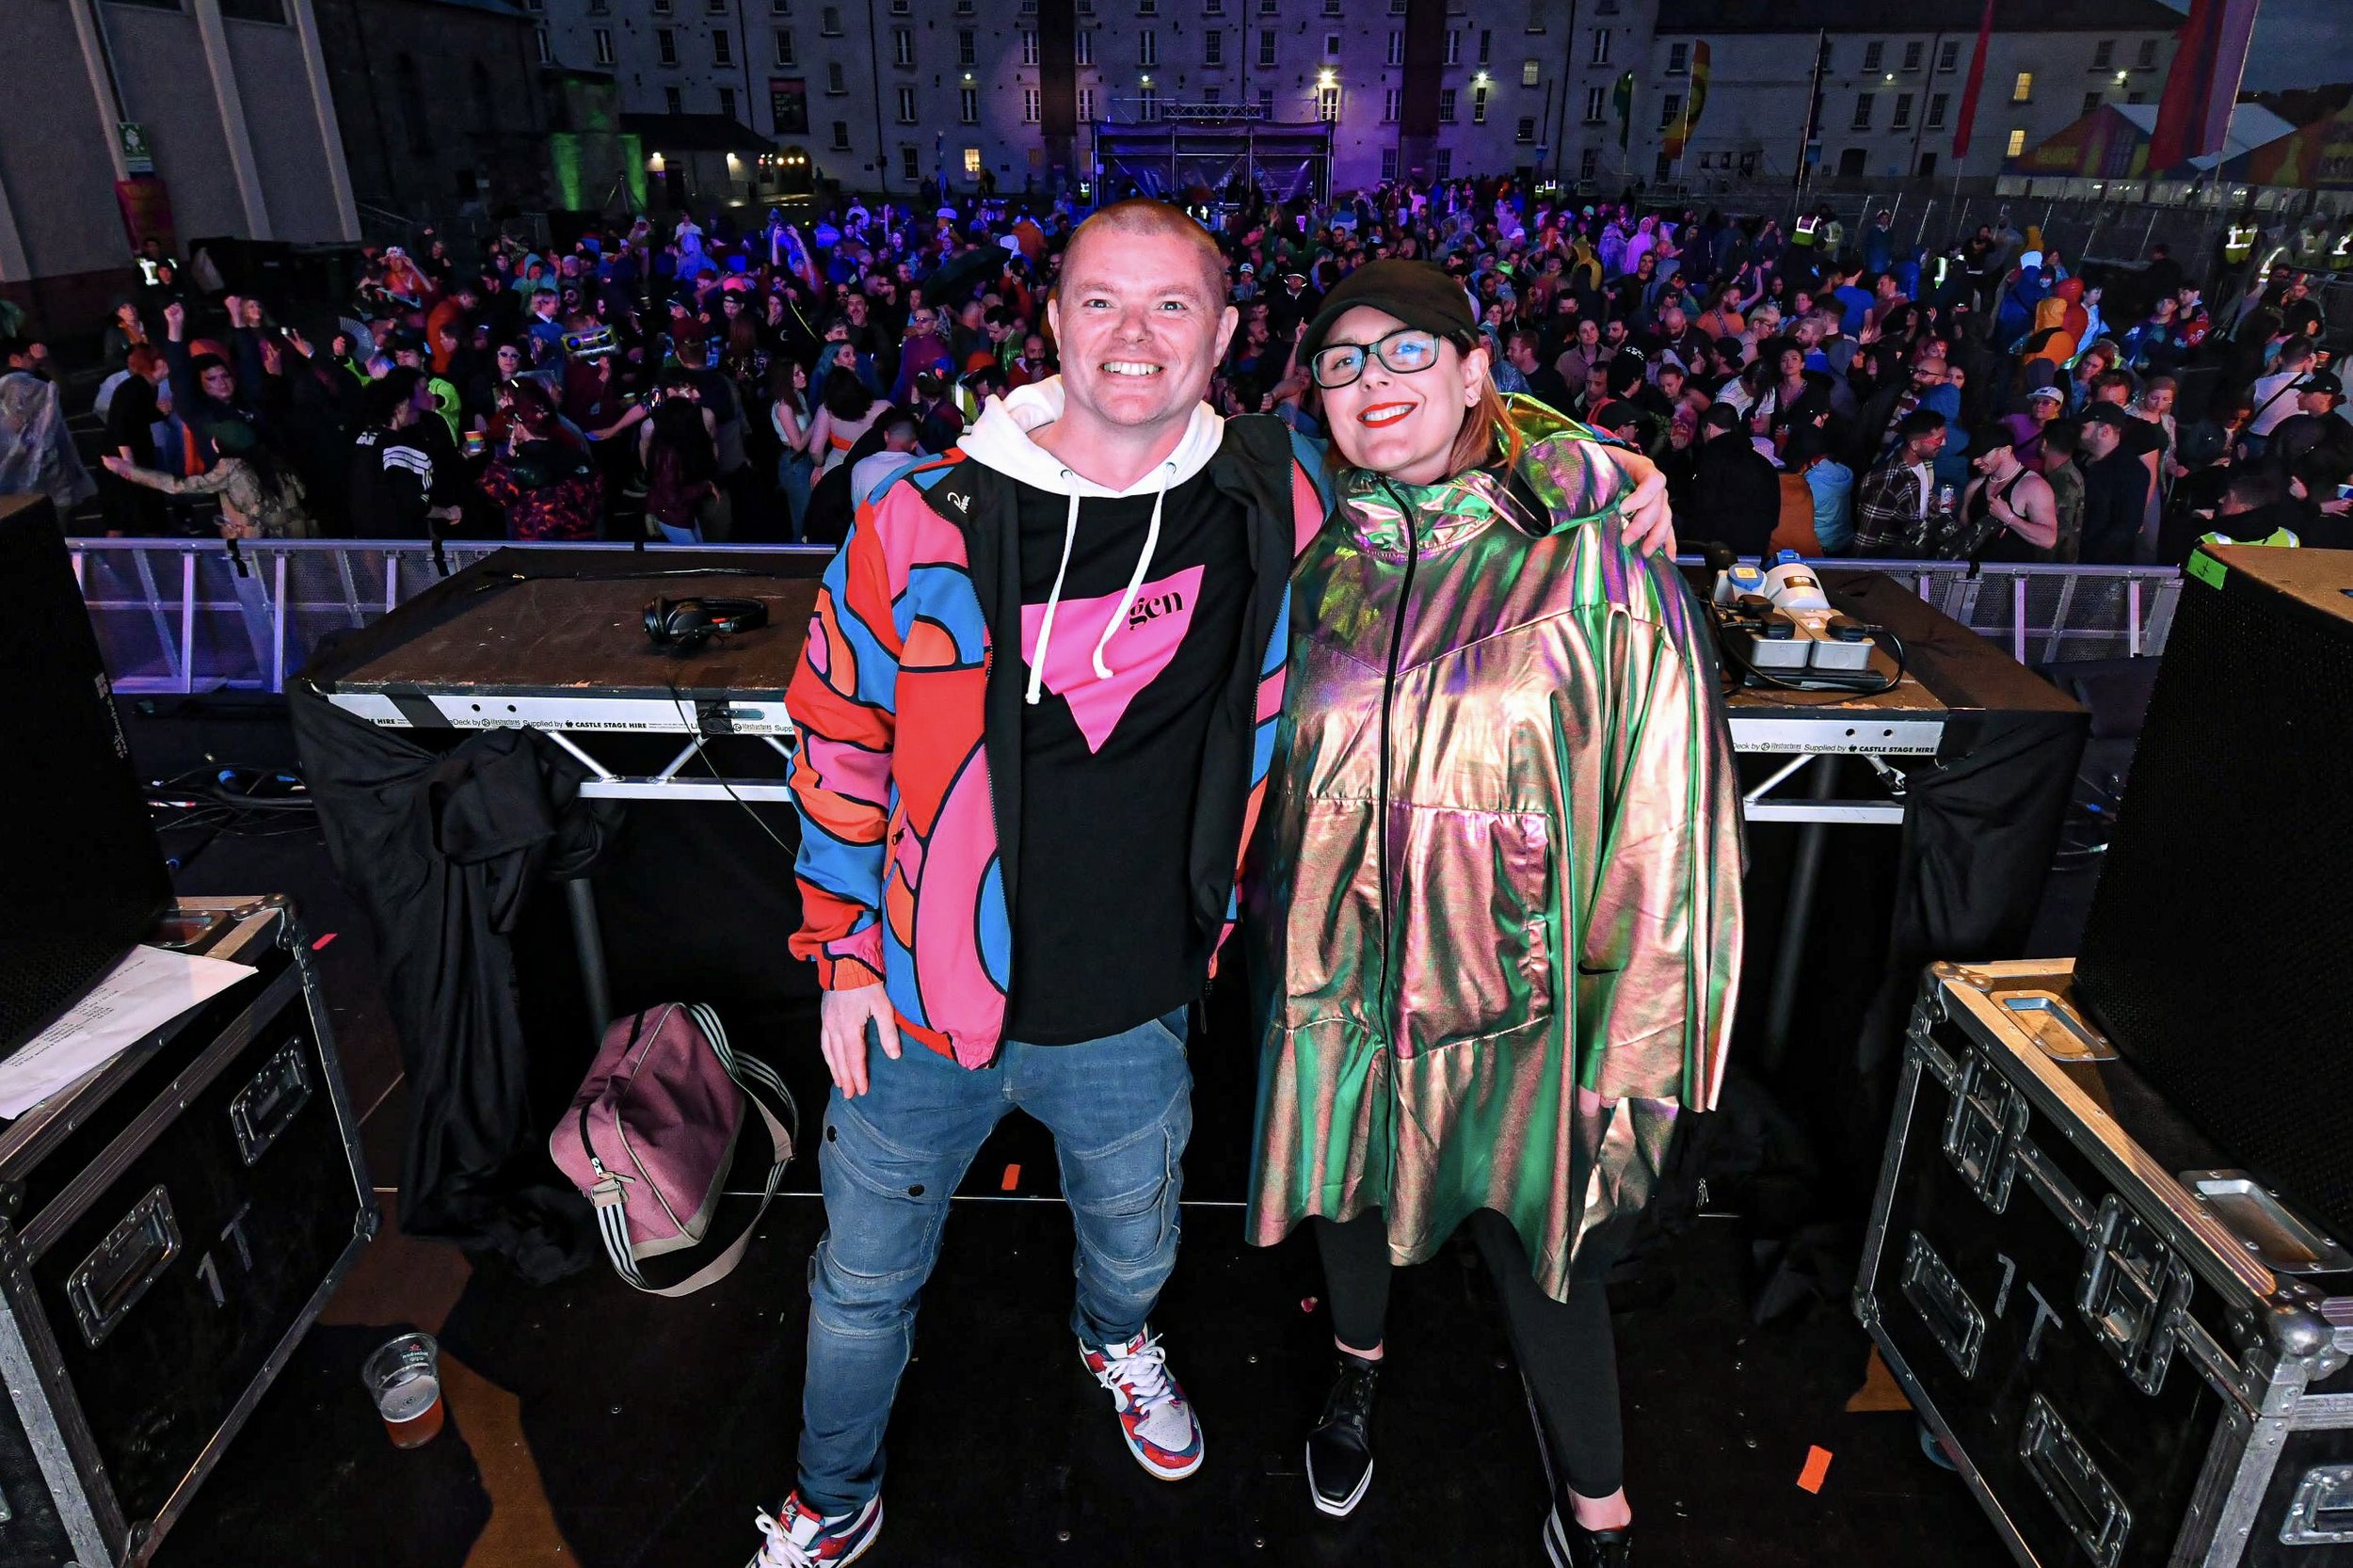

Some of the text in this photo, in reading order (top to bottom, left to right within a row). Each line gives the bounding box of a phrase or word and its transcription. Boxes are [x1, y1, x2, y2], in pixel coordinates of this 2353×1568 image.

[1129, 592, 1183, 631] gcn
[522, 719, 553, 728] Supplied
[554, 720, 563, 728] by
[1804, 744, 1836, 752] Supplied
